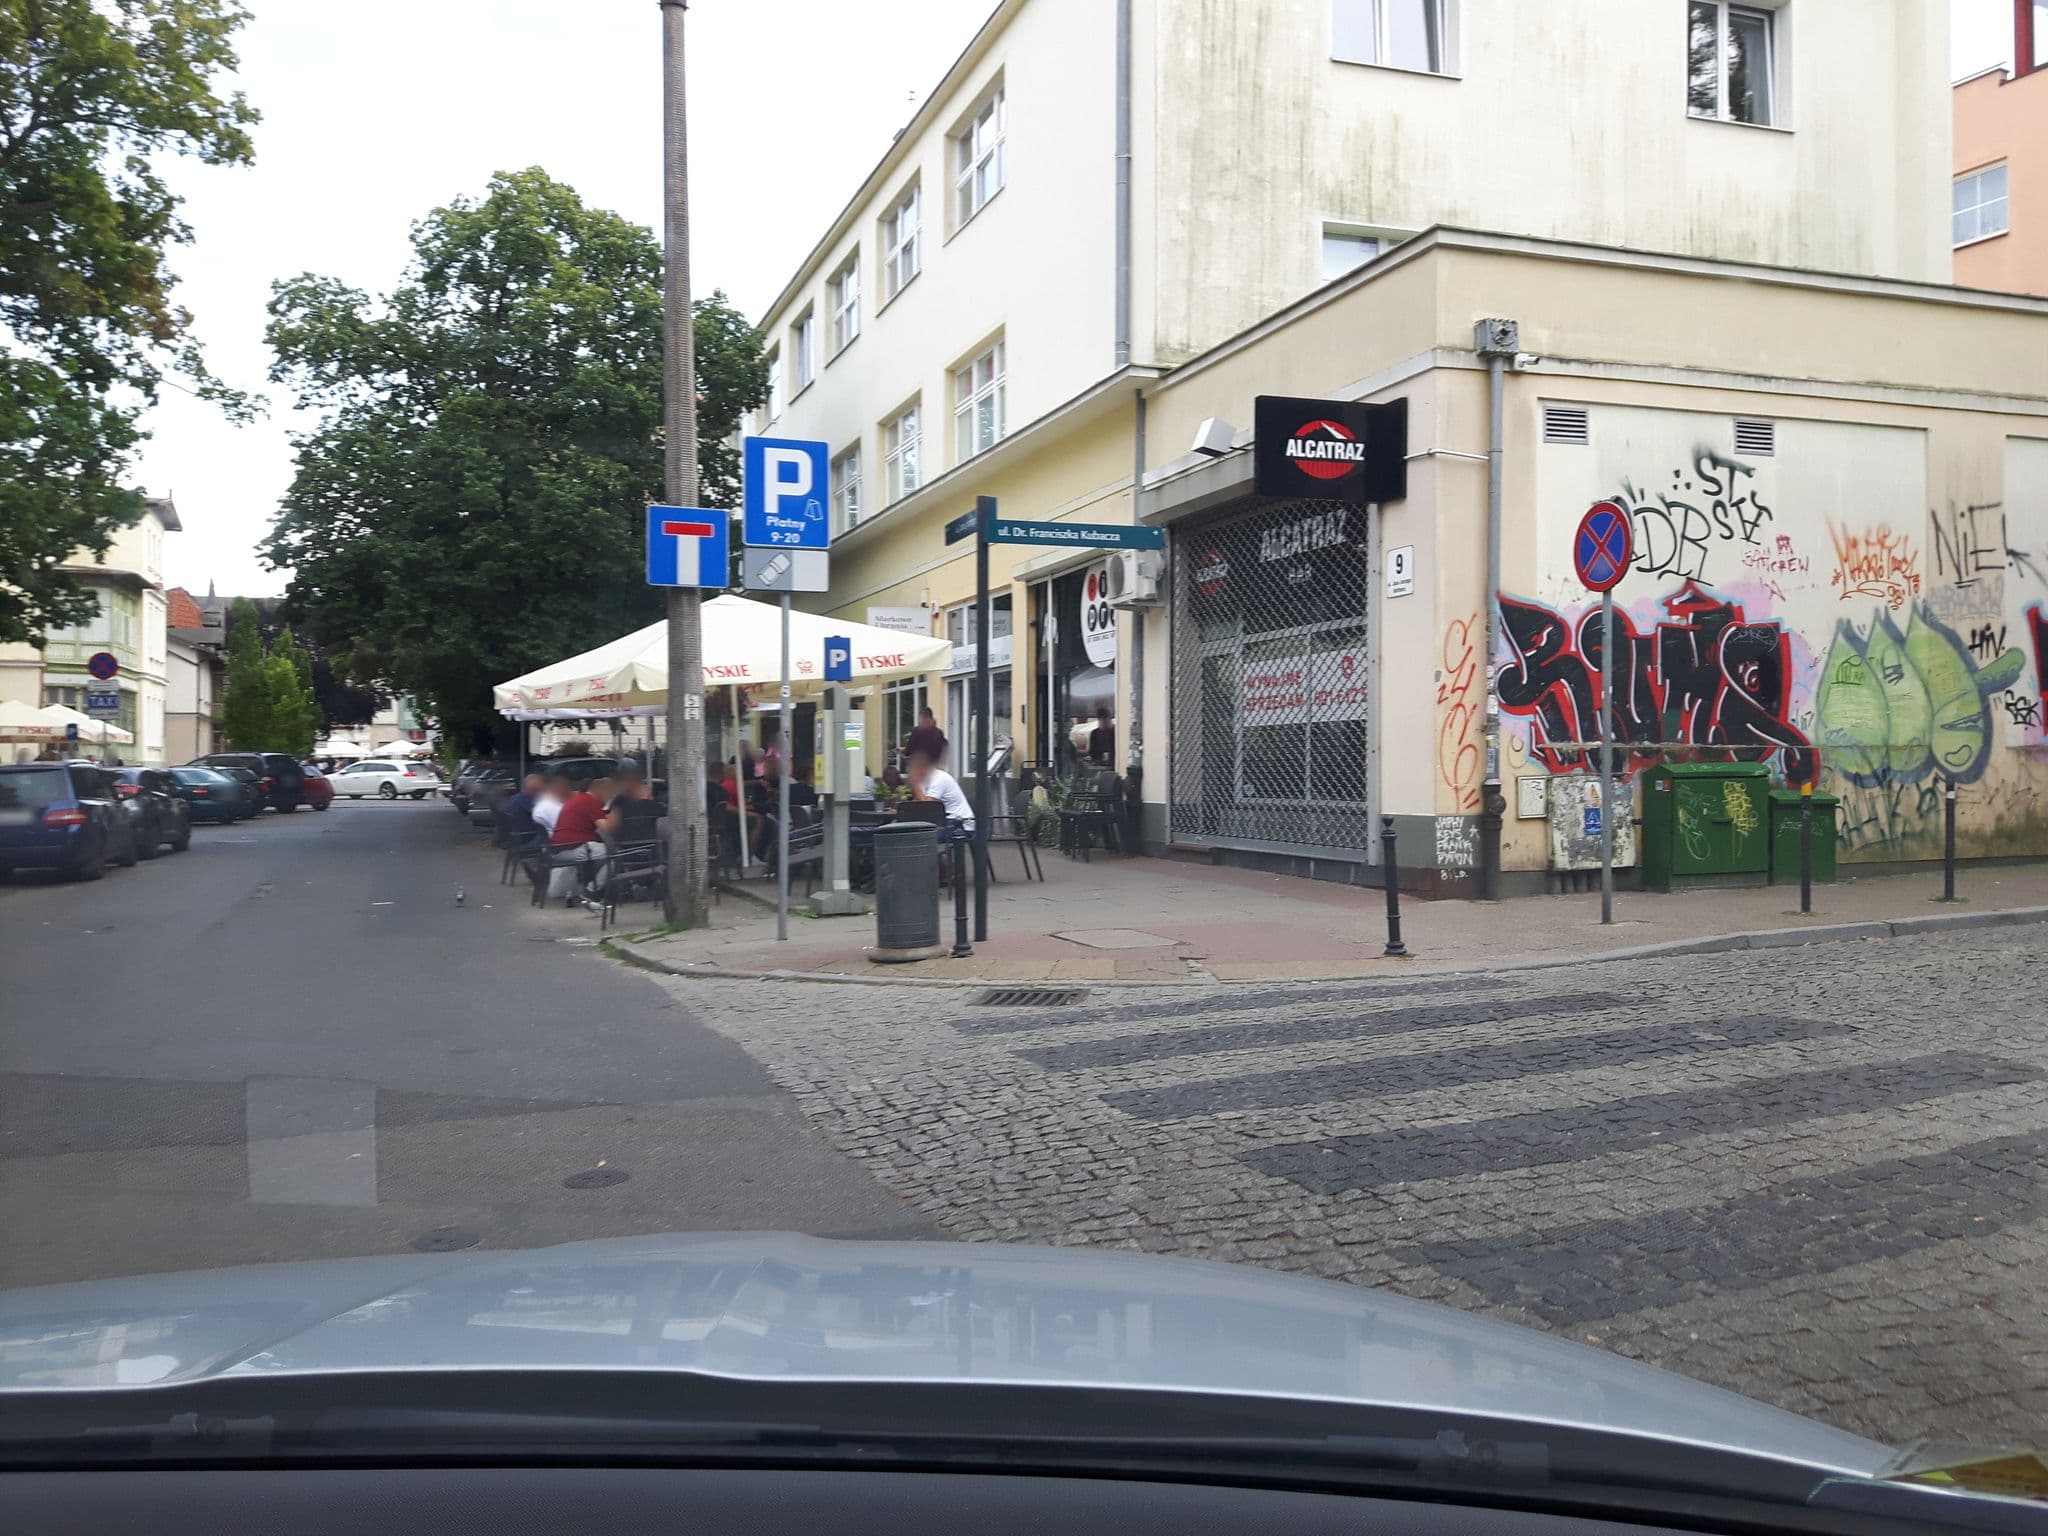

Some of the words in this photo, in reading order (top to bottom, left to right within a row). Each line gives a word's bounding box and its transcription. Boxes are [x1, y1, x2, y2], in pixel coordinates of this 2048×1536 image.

[1286, 438, 1365, 461] ALCATRAZ
[764, 447, 813, 514] P
[771, 531, 800, 543] 9-20
[998, 526, 1009, 536] ul.
[1013, 526, 1027, 537] Dr.
[1029, 528, 1079, 540] Franciszka
[1080, 530, 1121, 541] Kubacza
[1396, 553, 1403, 574] 9
[829, 649, 847, 668] P
[857, 654, 906, 669] TYSKIE
